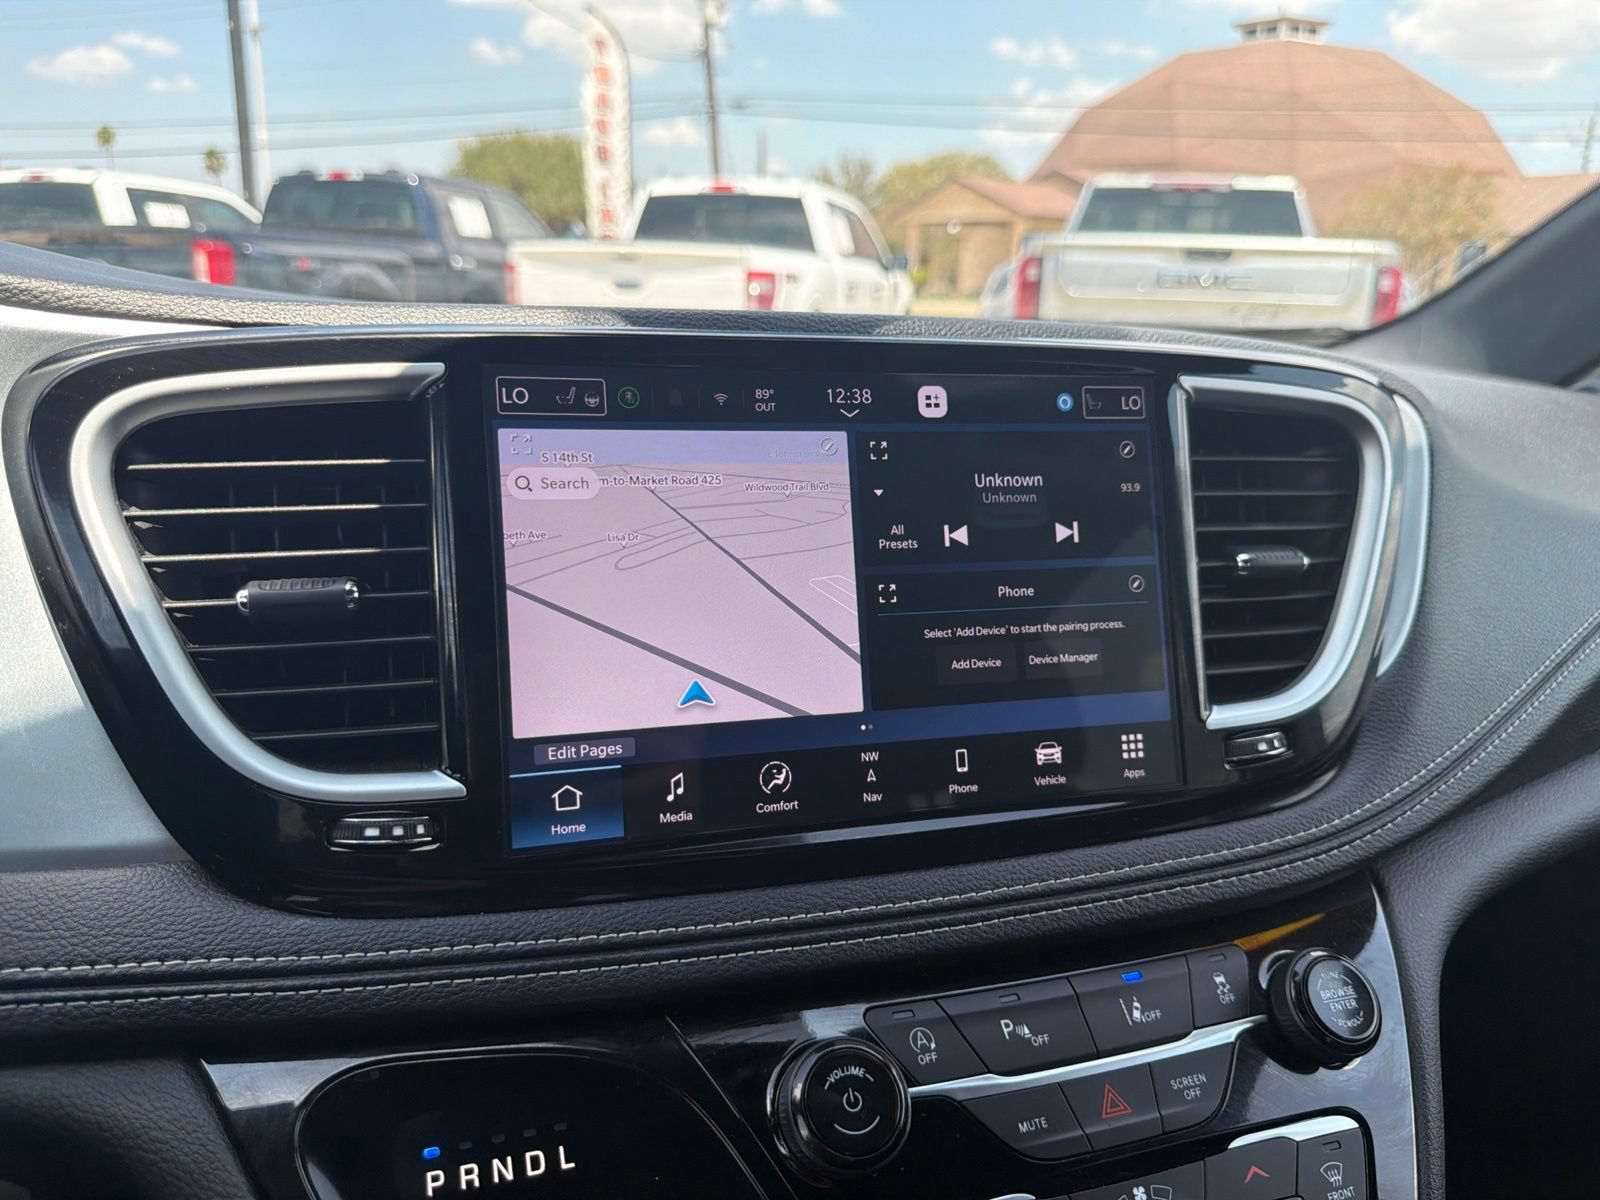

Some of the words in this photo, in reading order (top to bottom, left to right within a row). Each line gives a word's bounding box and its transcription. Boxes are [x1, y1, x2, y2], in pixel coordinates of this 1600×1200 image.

[501, 387, 529, 404] LO
[755, 389, 775, 400] 89°
[827, 388, 872, 404] 12:38
[755, 403, 776, 412] OUT
[1121, 396, 1141, 411] LO
[541, 453, 549, 462] S
[553, 453, 579, 462] 14th
[582, 453, 593, 462] St
[541, 477, 589, 489] Search
[671, 476, 699, 485] Road
[701, 475, 722, 485] 425
[974, 473, 1043, 487] Unknown
[744, 482, 789, 491] Wildwood
[1120, 483, 1140, 492] 93.9
[982, 492, 1037, 503] Unknown
[528, 531, 547, 539] Ave
[891, 525, 904, 535] All
[628, 533, 639, 541] Dr
[878, 539, 918, 549] Presets
[998, 585, 1035, 598] Phone
[924, 629, 952, 639] Select
[1010, 625, 1019, 633] to
[1022, 623, 1041, 633] start
[1043, 622, 1057, 631] the
[1059, 620, 1088, 632] pairing
[1090, 620, 1125, 630] process.
[951, 660, 969, 669] Add
[972, 658, 1001, 668] Device
[1029, 655, 1058, 665] Device
[1060, 652, 1098, 664] Manager
[548, 746, 576, 760] Edit
[580, 743, 622, 759] Pages
[861, 751, 879, 762] NW
[1124, 767, 1144, 779] Apps
[1034, 775, 1066, 786] Vehicle
[949, 783, 978, 794] Phone
[863, 792, 882, 802] Nav
[756, 800, 799, 812] Comfort
[660, 811, 692, 823] Media
[551, 822, 586, 834] Home
[1219, 994, 1235, 1003] OFF
[1320, 986, 1355, 999] BROWSE
[1330, 999, 1358, 1012] ENTER
[1145, 1009, 1162, 1020] OFF
[1337, 1014, 1363, 1028] SCROLL
[1031, 1034, 1049, 1046] OFF
[918, 1052, 937, 1064] OFF
[829, 1066, 865, 1083] VOLUME
[1170, 1073, 1206, 1090] SCREEN
[1184, 1089, 1201, 1099] OFF
[1018, 1117, 1048, 1132] MUTE
[425, 1170, 445, 1197] P
[459, 1163, 480, 1190] R
[492, 1156, 514, 1183] N
[524, 1150, 546, 1176] D
[558, 1145, 576, 1170] L
[1328, 1187, 1356, 1200] FRONT
